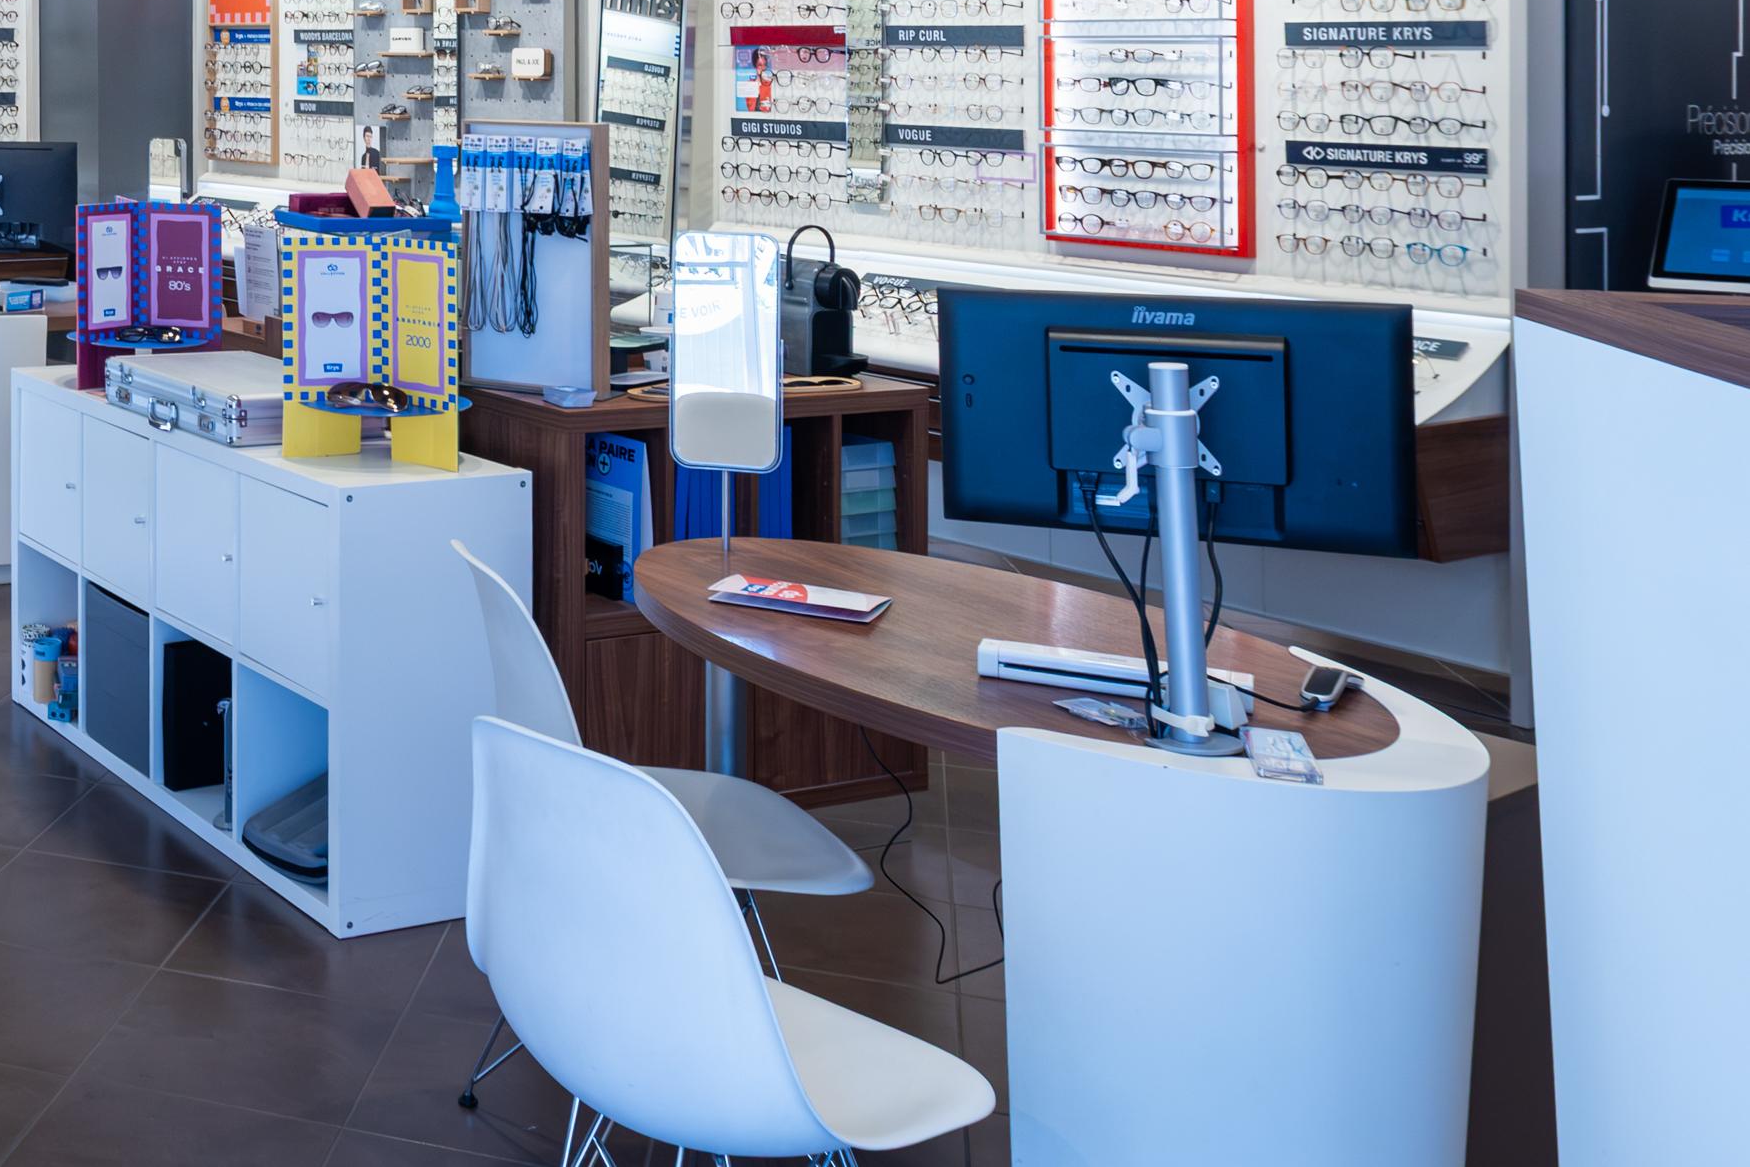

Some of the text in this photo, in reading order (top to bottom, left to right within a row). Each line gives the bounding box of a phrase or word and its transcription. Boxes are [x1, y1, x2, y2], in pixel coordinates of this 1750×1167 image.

[300, 33, 353, 41] WOODYS BARCELONA
[898, 30, 946, 42] RIP CURL
[1302, 27, 1433, 41] SIGNATURE KRYS
[742, 122, 802, 135] GIGI STUDIOS
[898, 129, 932, 141] VOGUE
[1326, 148, 1393, 163] SIGNATURE
[1394, 151, 1428, 165] KRYS
[155, 265, 205, 273] GRACE
[168, 280, 191, 291] 80's
[1131, 306, 1196, 326] iiyama
[405, 334, 432, 348] 2000
[599, 441, 636, 463] PAIRE
